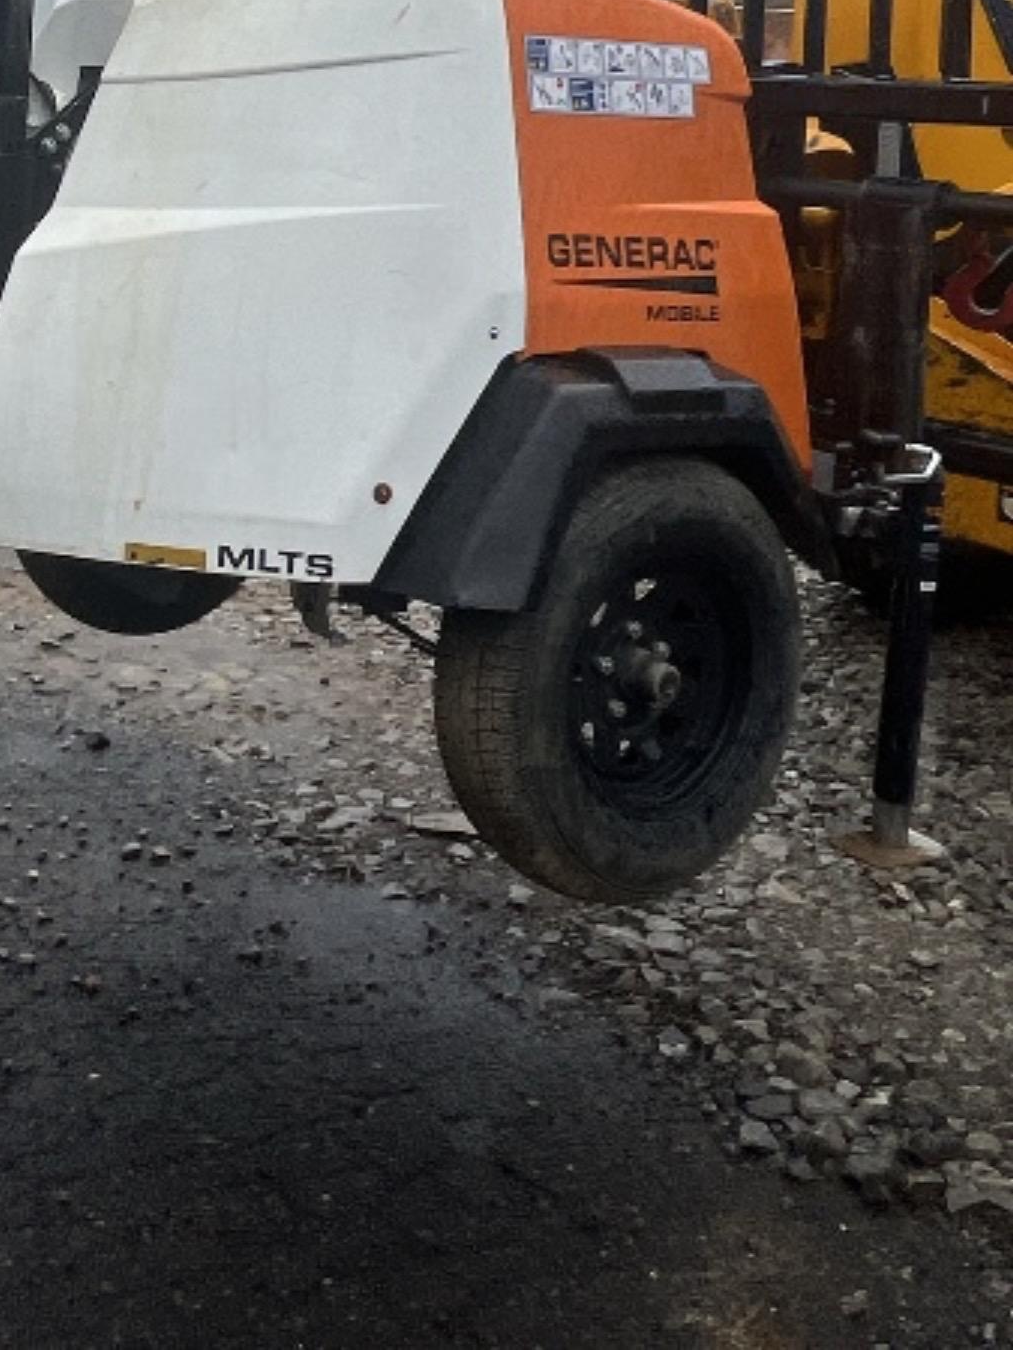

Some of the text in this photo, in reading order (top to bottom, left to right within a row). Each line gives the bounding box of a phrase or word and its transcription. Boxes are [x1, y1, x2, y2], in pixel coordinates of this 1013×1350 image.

[546, 233, 716, 271] GENERAC
[646, 305, 720, 322] MOBILE
[217, 545, 334, 579] MLTS
